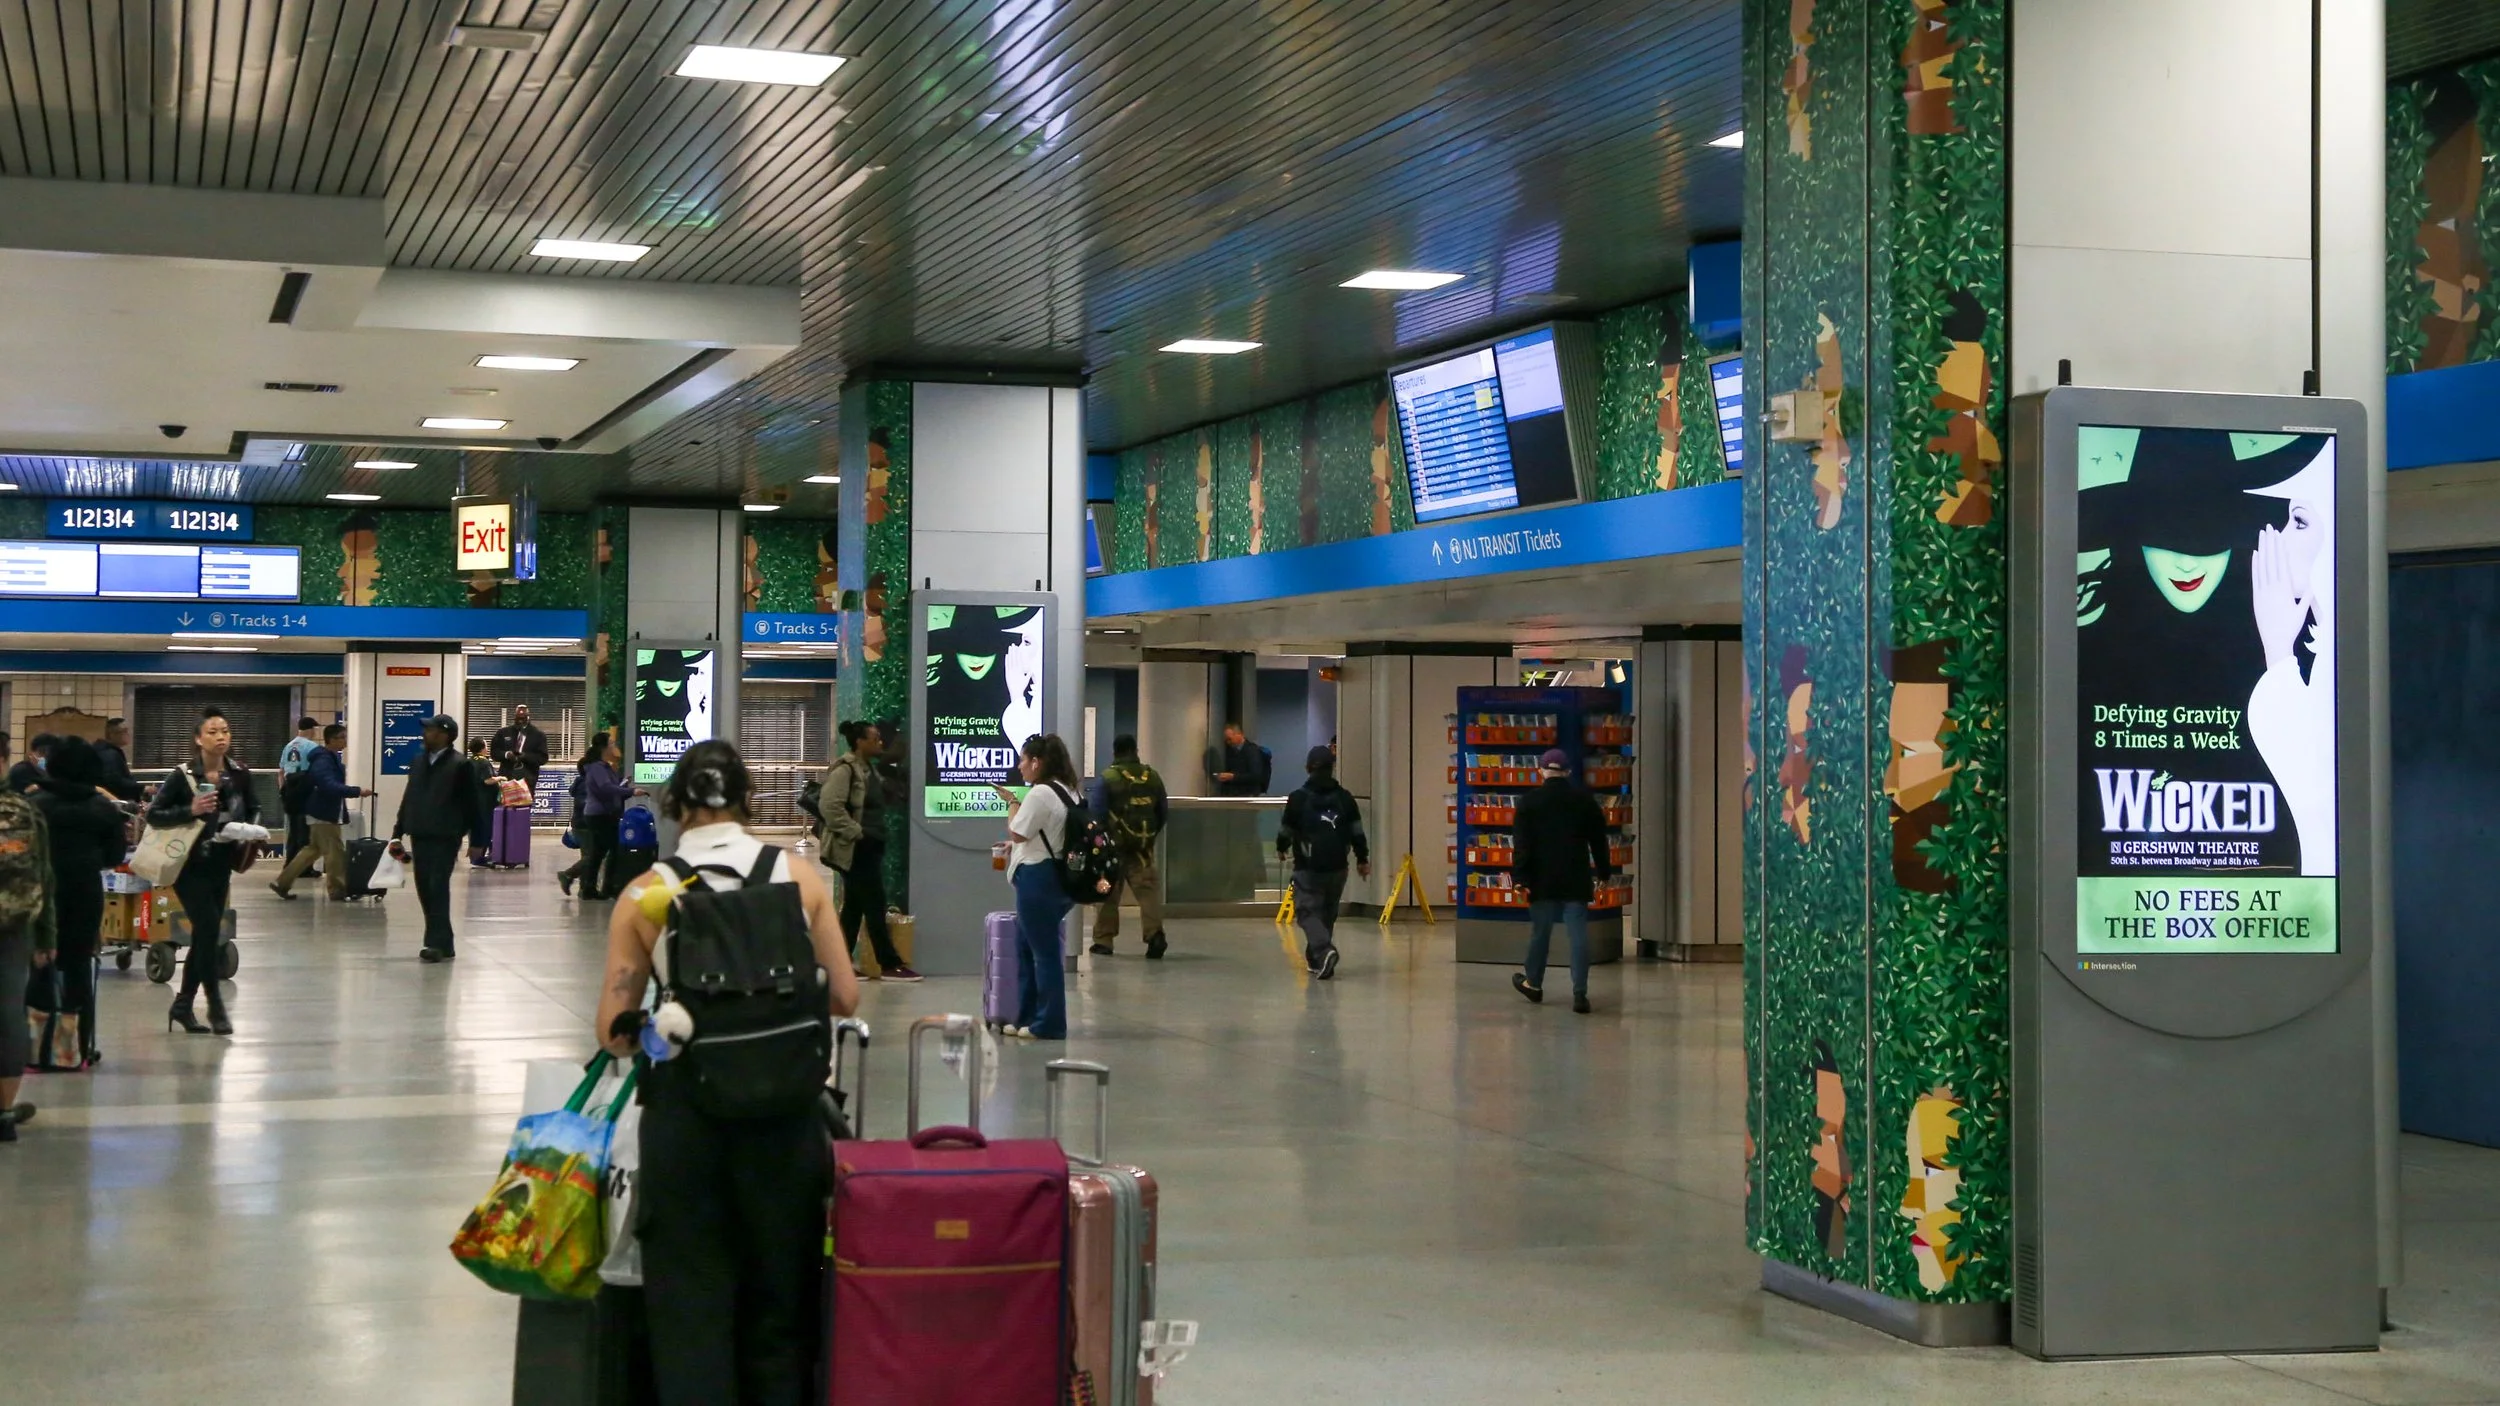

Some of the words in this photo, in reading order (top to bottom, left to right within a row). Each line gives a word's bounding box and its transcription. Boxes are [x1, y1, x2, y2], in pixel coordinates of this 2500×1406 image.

[463, 518, 506, 553] Exit
[1462, 538, 1478, 560] NJ
[1478, 531, 1521, 558] TRANSIT
[1522, 528, 1562, 552] Tickets
[230, 613, 277, 627] Tracks
[282, 614, 308, 627] 1-4
[774, 621, 815, 634] Tracks
[933, 716, 968, 727] Defying
[968, 717, 1000, 727] Gravity
[2093, 703, 2168, 728] Defying
[2172, 705, 2242, 729] Gravity
[933, 727, 940, 736] 8
[941, 727, 967, 736] Times
[976, 728, 1000, 736] Week
[2094, 730, 2107, 748] 8
[2111, 730, 2168, 749] Times
[2173, 735, 2185, 748] a
[2190, 731, 2241, 750] Week
[951, 791, 967, 800] NO
[970, 791, 998, 801] FEES
[535, 799, 549, 808] 50
[938, 802, 961, 811] THE
[964, 802, 989, 811] BOX
[2122, 841, 2195, 854] GERSHWIN
[2197, 841, 2259, 855] THEATRE
[2110, 856, 2128, 865] 50th
[2129, 857, 2140, 865] St.
[2141, 856, 2173, 866] between
[2174, 856, 2211, 867] Broadway
[2213, 857, 2228, 866] and
[2228, 857, 2241, 866] 8th
[2243, 857, 2260, 866] Ave.
[2134, 890, 2170, 912] NO
[2179, 890, 2240, 912] FEES
[2248, 890, 2281, 911] AT
[2104, 916, 2157, 939] THE
[2165, 917, 2217, 939] BOX
[2224, 917, 2311, 939] OFFICE
[2091, 962, 2137, 971] Intersection
